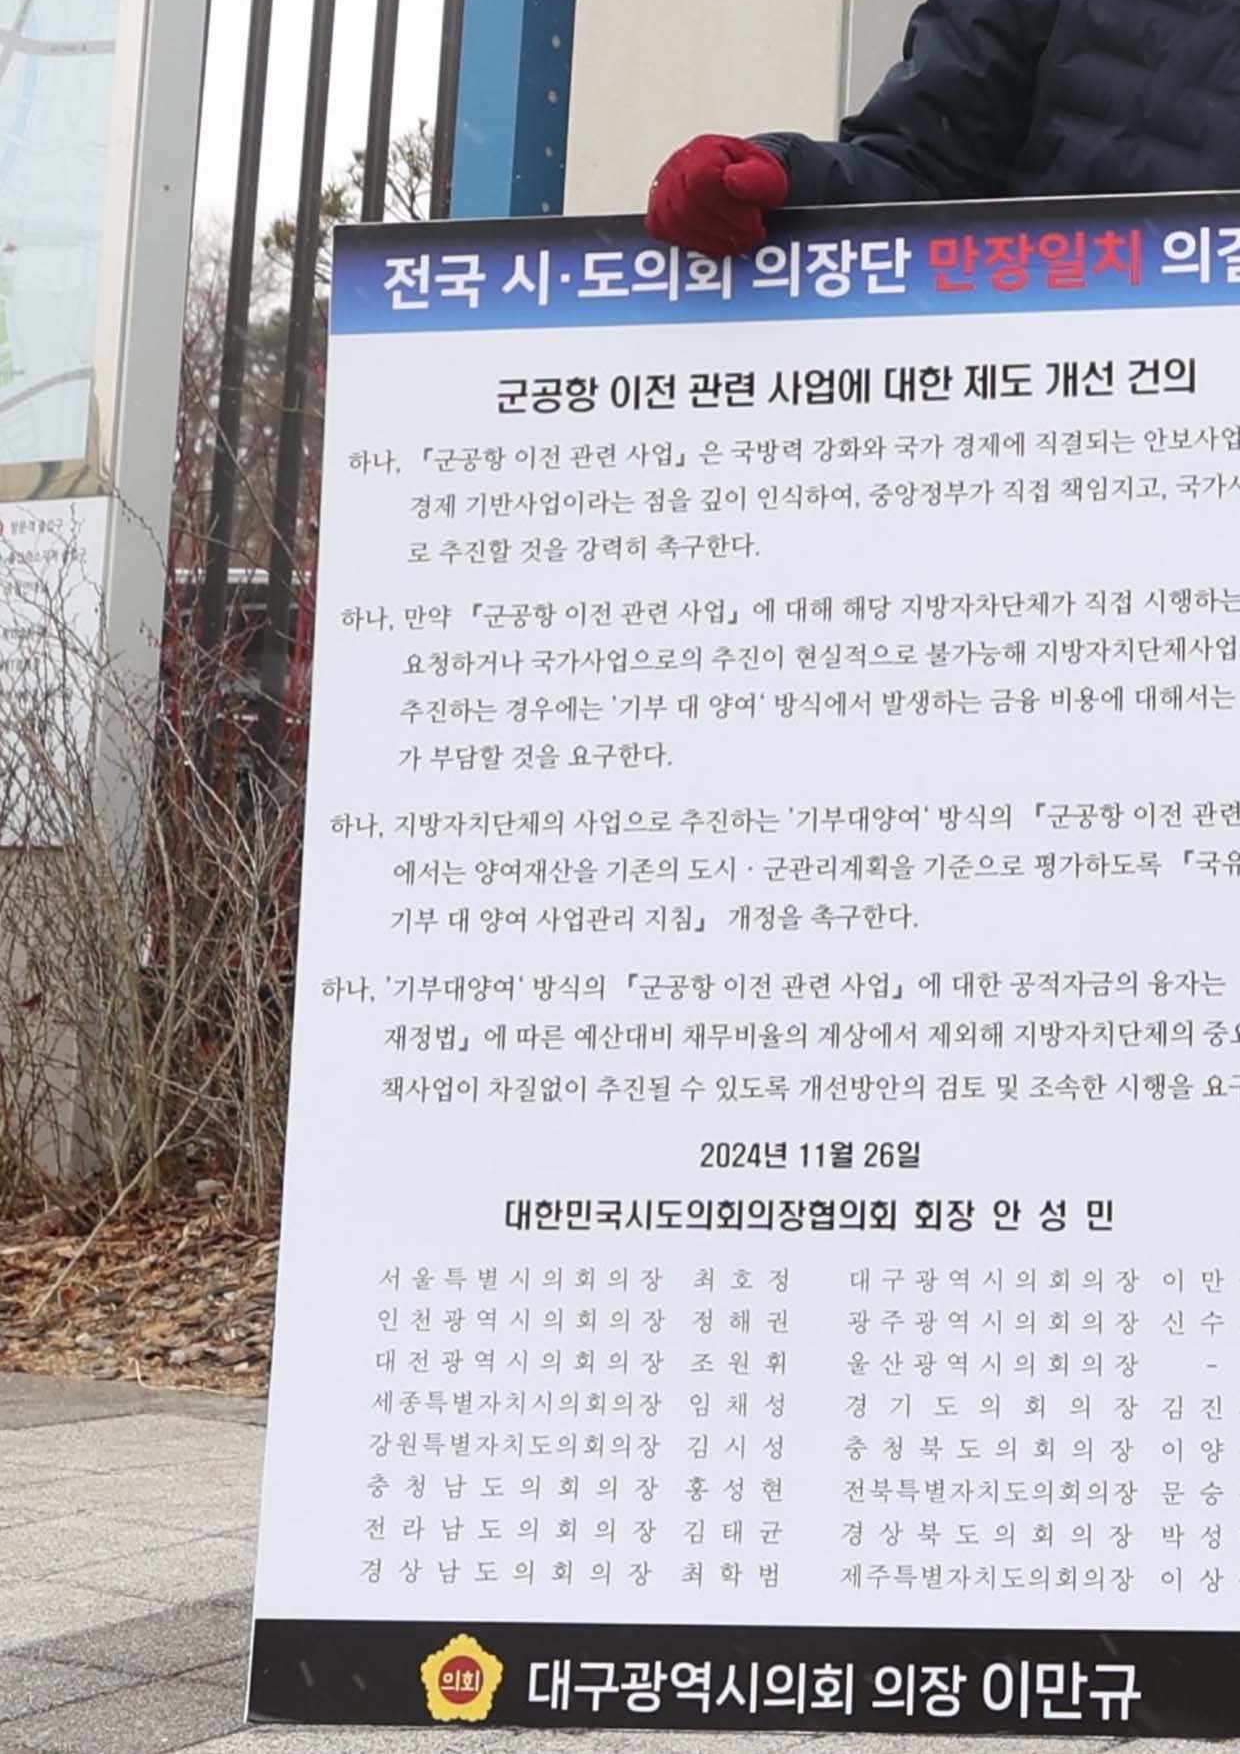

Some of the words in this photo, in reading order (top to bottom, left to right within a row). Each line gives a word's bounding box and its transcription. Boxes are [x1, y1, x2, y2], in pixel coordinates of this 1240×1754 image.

[383, 253, 487, 311] 전국
[752, 237, 913, 299] 의장단
[930, 229, 1142, 292] 만장일치
[495, 374, 601, 416] 군공항
[609, 372, 677, 412] 이전
[687, 370, 756, 410] 관련
[766, 366, 872, 408] 사업에
[883, 364, 955, 404] 대한
[962, 362, 1034, 402] 제도
[1044, 359, 1115, 399] 개선
[1127, 356, 1197, 397] 건의
[410, 492, 457, 520] 경제
[466, 488, 635, 519] 기반사업이라는
[645, 486, 692, 515] 점을
[701, 484, 747, 513] 깊이
[756, 482, 861, 512] 인식하여,
[868, 478, 995, 509] 중앙정부가
[1004, 476, 1050, 505] 직접
[1061, 474, 1167, 503] 책임지고,
[407, 541, 431, 564] 로
[439, 537, 513, 566] 추진할
[521, 536, 569, 564] 것을
[576, 534, 647, 563] 강력히
[655, 531, 761, 560] 촉구한다.
[401, 649, 525, 679] 요청하거나
[531, 645, 703, 676] 국가사업으로의
[711, 643, 785, 673] 추진이
[794, 641, 919, 671] 현실적으로
[925, 638, 1026, 668] 불가능해
[398, 744, 423, 773] 가
[429, 743, 504, 772] 부담할
[512, 742, 561, 770] 것을
[567, 740, 673, 770] 요구한다.
[392, 858, 467, 887] 에서는
[473, 857, 599, 886] 양여재산을
[607, 855, 679, 885] 기존의
[687, 854, 736, 883] 도시
[762, 852, 916, 883] 군관리계획을
[924, 852, 1025, 881] 기준으로
[1034, 850, 1162, 881] 평가하도록
[390, 906, 439, 935] 기부
[447, 906, 470, 934] 대
[479, 905, 527, 935] 양여
[537, 904, 635, 934] 사업관리
[728, 903, 804, 933] 개정을
[809, 902, 919, 932] 촉구한다.
[515, 1022, 566, 1051] 따른
[573, 1022, 673, 1051] 예산대비
[682, 1021, 808, 1051] 채무비율의
[817, 1020, 918, 1050] 계상에서
[928, 1020, 1004, 1050] 제외해
[1014, 1018, 1194, 1050] 지방자치단체의
[382, 1074, 479, 1104] 책사업이
[488, 1074, 588, 1104] 차질없이
[596, 1074, 671, 1104] 추진될
[679, 1074, 706, 1104] 수
[714, 1074, 791, 1103] 있도록
[799, 1073, 926, 1103] 개선방안의
[937, 1072, 986, 1102] 검토
[995, 1073, 1019, 1102] 및
[1029, 1072, 1108, 1102] 조속한
[1115, 1072, 1194, 1102] 시행을
[699, 1140, 788, 1170] 2024년
[798, 1139, 854, 1170] 11월
[862, 1140, 921, 1170] 26일
[504, 1197, 898, 1233] 대한민국시도의회의장협의회
[913, 1198, 976, 1234] 회장
[440, 1668, 481, 1694] 의회
[528, 1658, 855, 1716] 대구광역시의회
[871, 1663, 968, 1718] 의장
[982, 1659, 1142, 1721] 이만규
